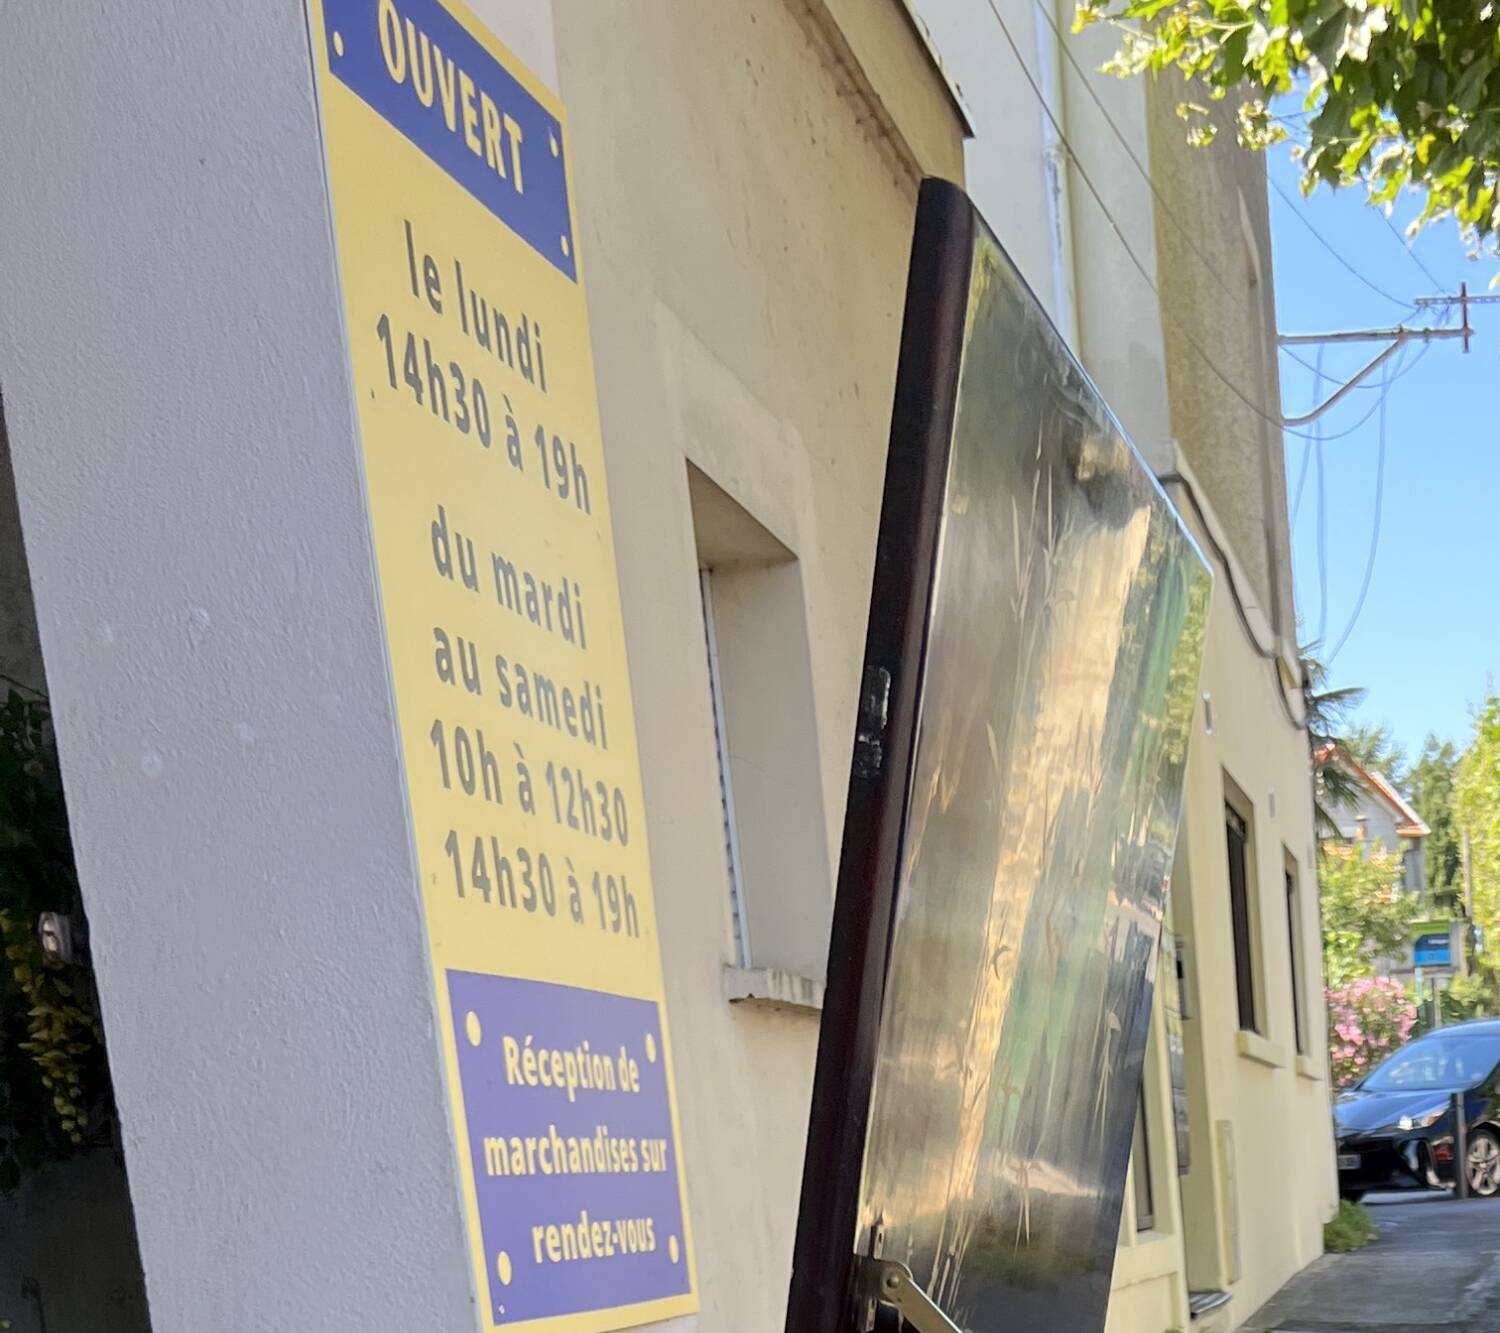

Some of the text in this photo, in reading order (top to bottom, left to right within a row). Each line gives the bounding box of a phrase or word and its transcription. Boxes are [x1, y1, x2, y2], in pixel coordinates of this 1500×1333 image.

[377, 0, 524, 195] OUVERT
[403, 219, 548, 394] le lundi
[376, 313, 591, 516] 14h30 à 19h
[431, 504, 587, 650] du mardi
[433, 626, 609, 750] au samedi
[430, 718, 630, 848] 10h à 12h30
[444, 829, 641, 938] 14h30 à 19h
[503, 1035, 640, 1102] Réception de
[484, 1125, 667, 1176] marchandises sur
[532, 1210, 657, 1264] rendez-vous
